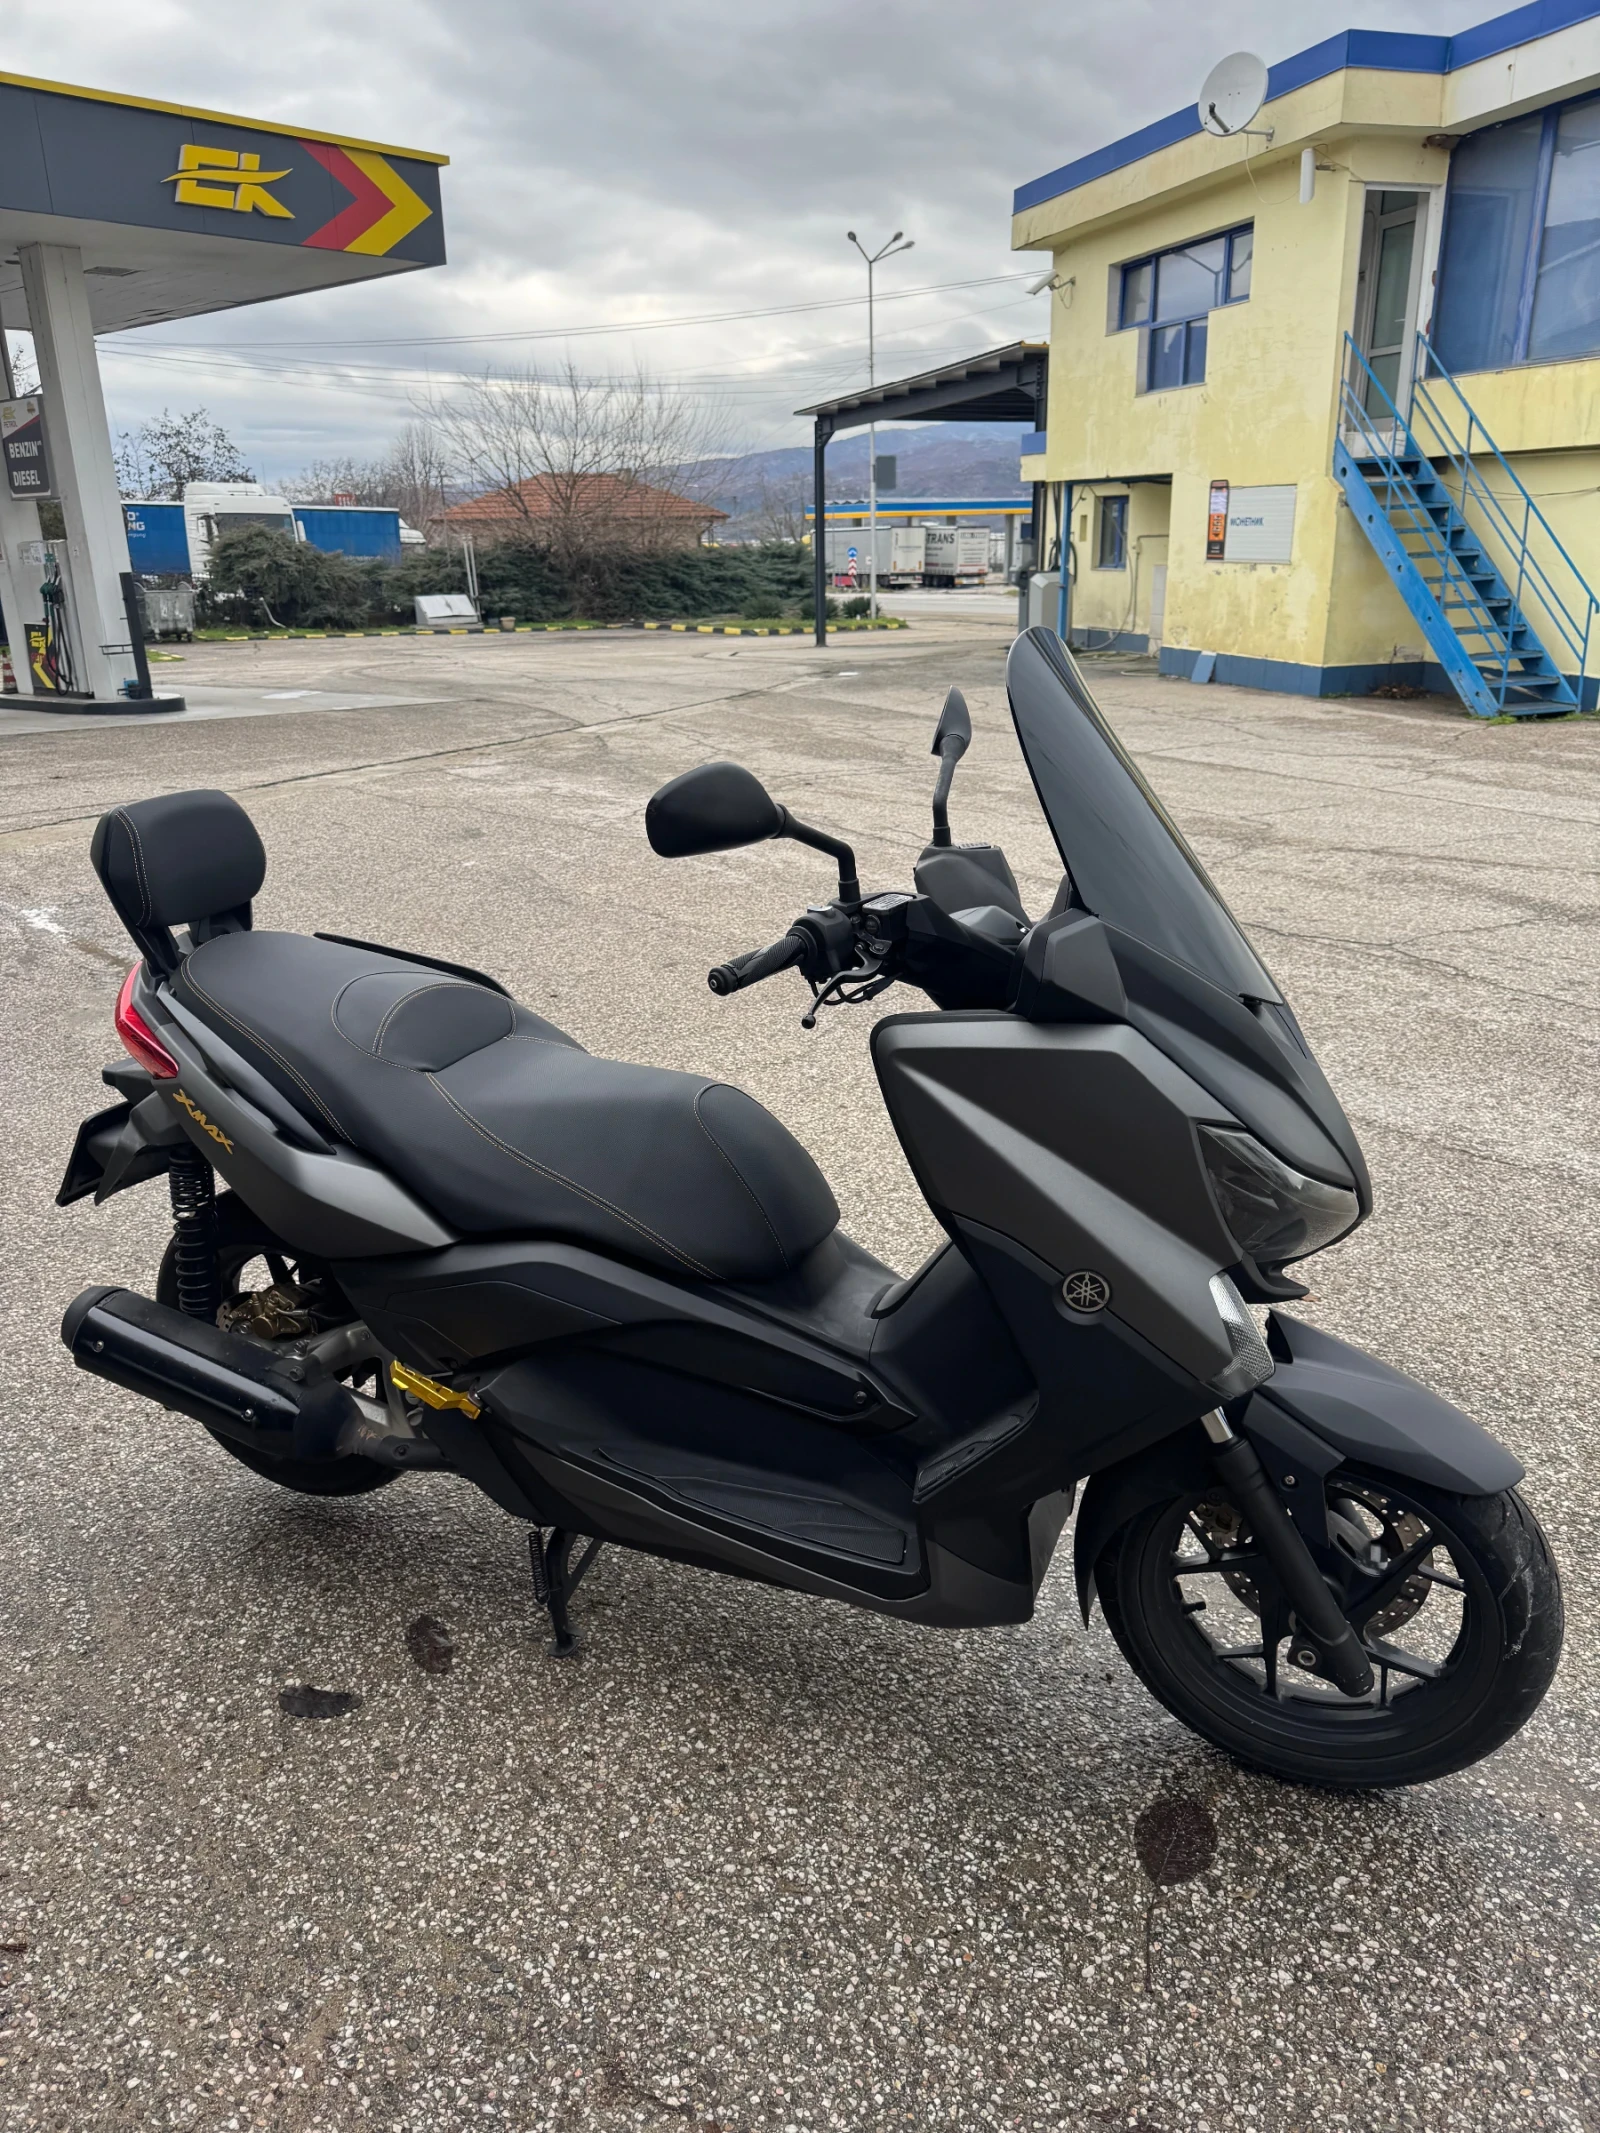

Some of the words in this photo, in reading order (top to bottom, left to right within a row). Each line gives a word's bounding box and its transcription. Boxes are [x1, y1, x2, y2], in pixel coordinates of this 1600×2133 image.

[8, 440, 39, 459] BENZIN
[12, 469, 41, 486] DIESEL
[926, 533, 955, 544] TRANS
